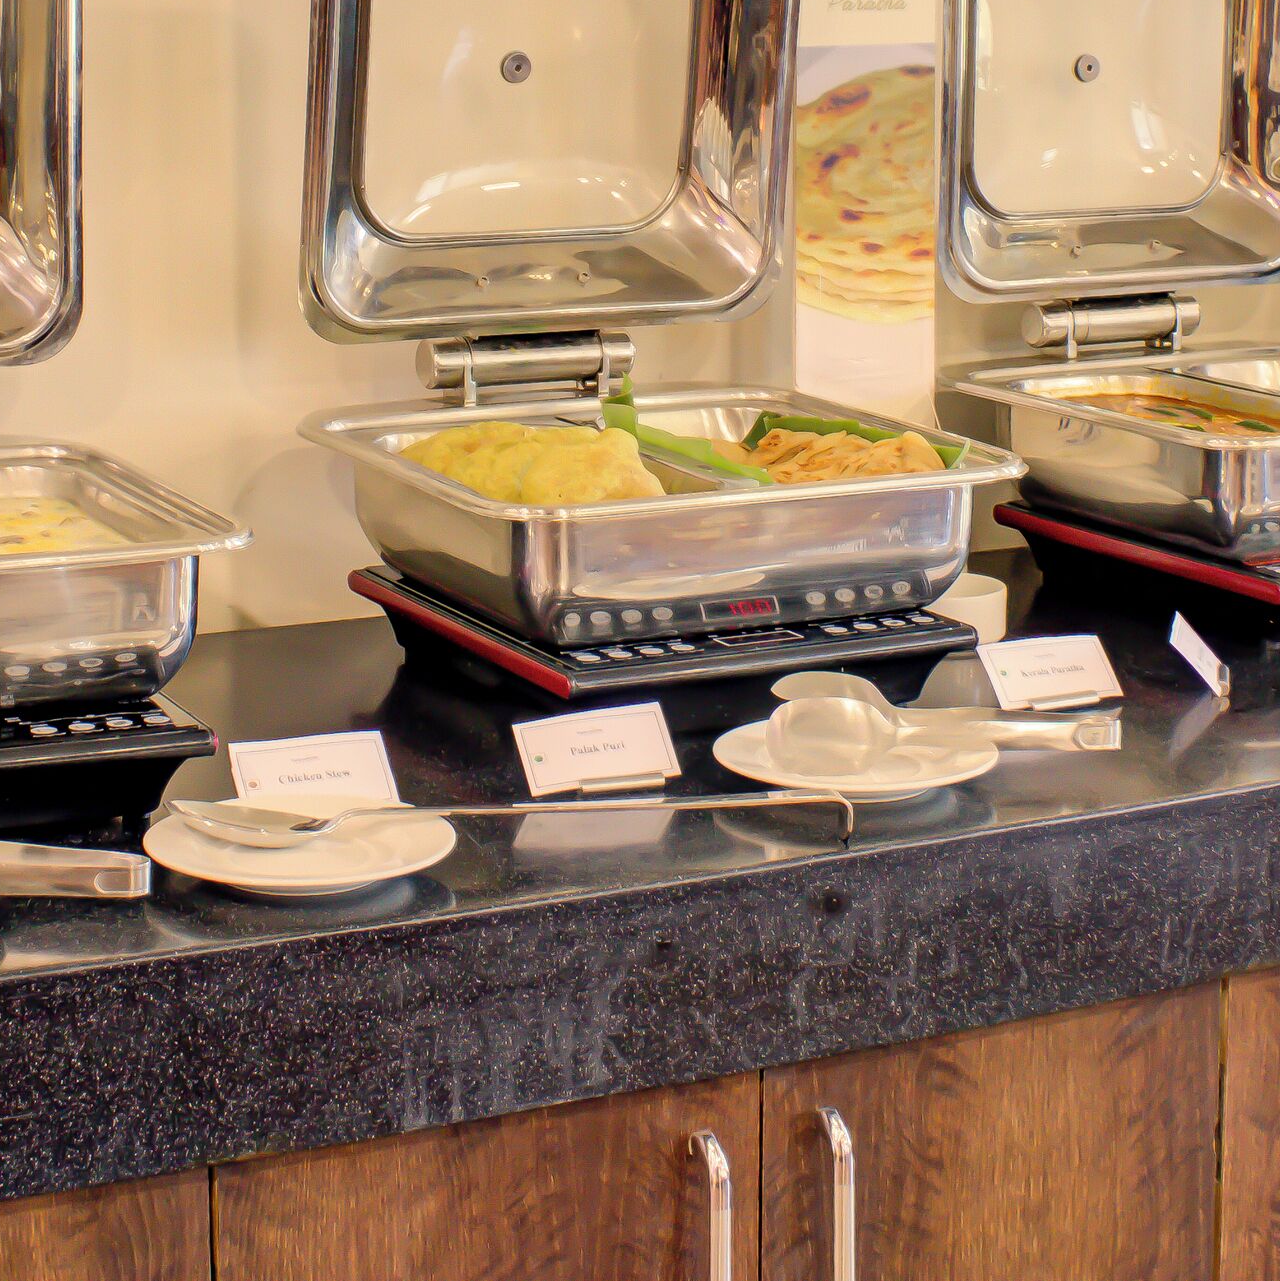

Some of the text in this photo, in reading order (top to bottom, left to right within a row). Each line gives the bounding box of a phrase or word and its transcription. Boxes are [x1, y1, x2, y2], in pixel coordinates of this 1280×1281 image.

[570, 740, 625, 756] Palak Puri
[278, 769, 351, 784] Chicken Stew
